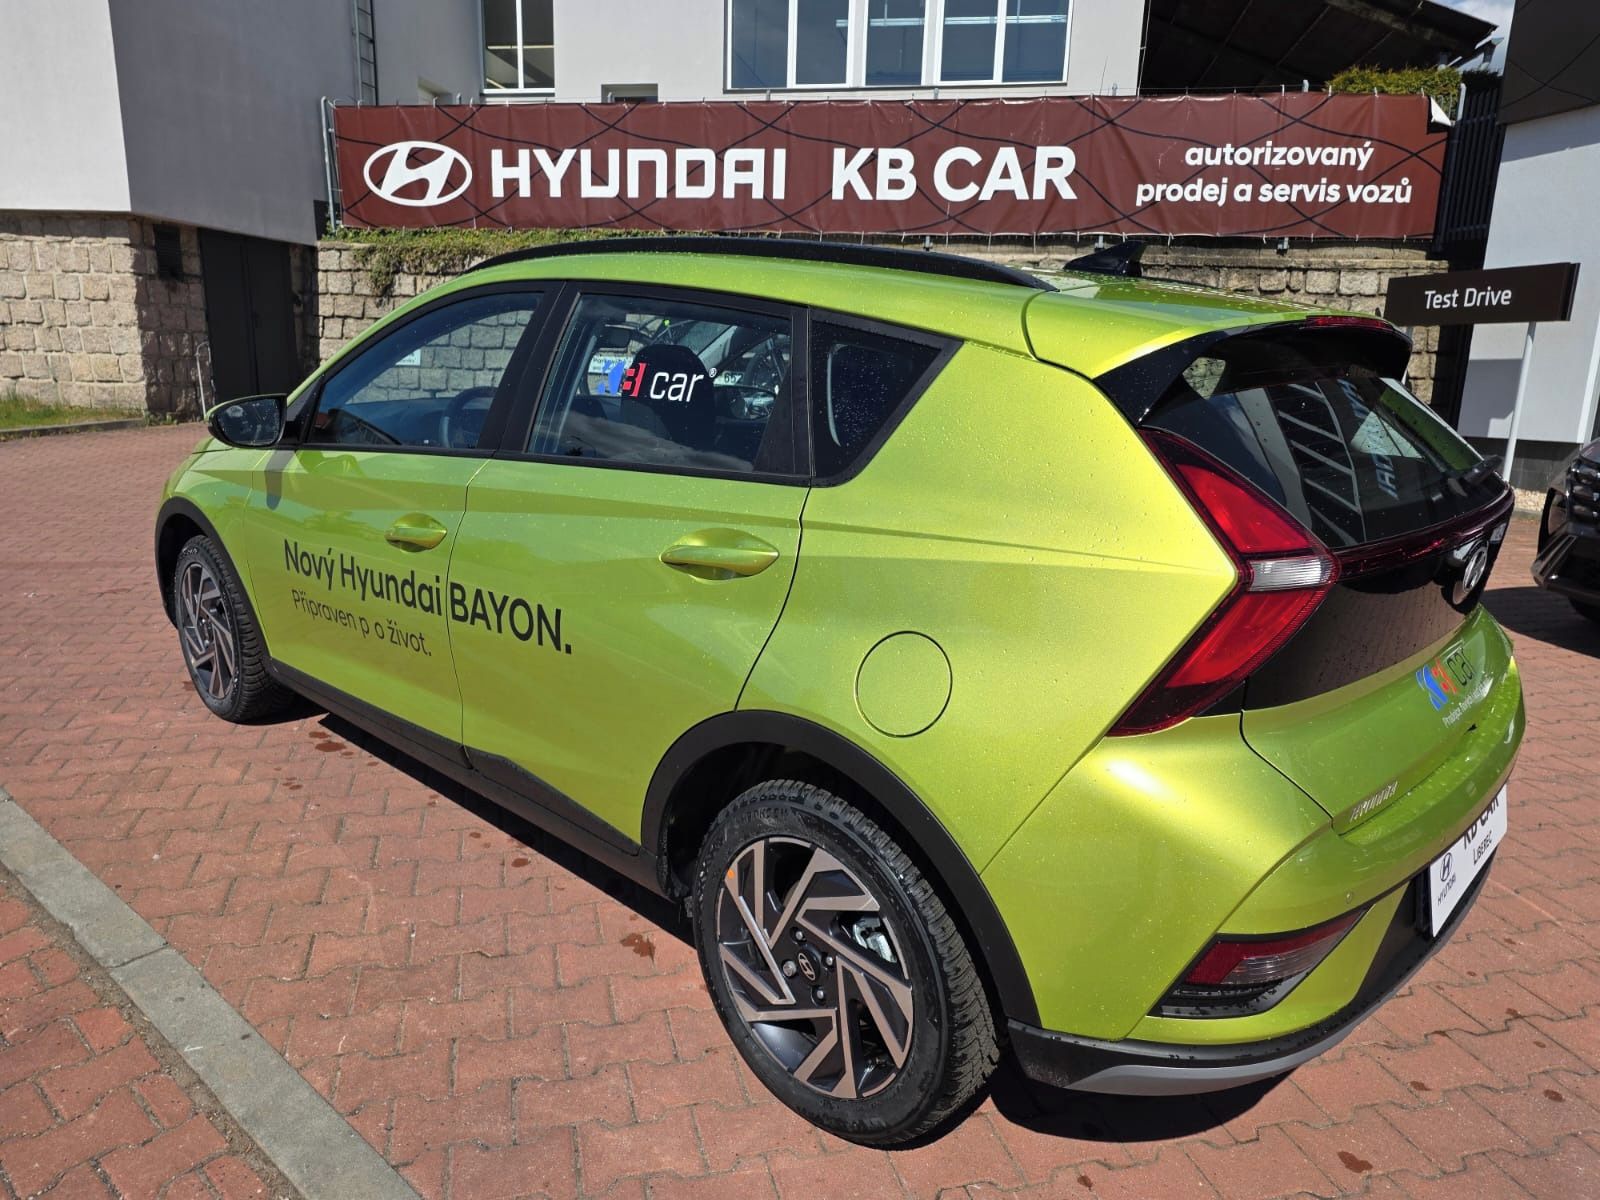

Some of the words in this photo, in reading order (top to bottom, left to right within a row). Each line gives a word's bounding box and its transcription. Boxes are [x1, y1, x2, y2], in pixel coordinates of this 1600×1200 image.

[490, 148, 786, 200] HYUNDAI
[831, 147, 918, 201] KB
[933, 146, 1078, 202] CAR
[1185, 141, 1374, 170] autorizovaný
[1136, 177, 1228, 207] prodej
[1233, 182, 1252, 202] a
[1258, 177, 1341, 202] servis
[1347, 177, 1412, 203] vozů
[1424, 289, 1459, 309] Test
[1463, 286, 1512, 307] Drive
[284, 538, 335, 591] Nový
[340, 553, 442, 616] Hyundai
[450, 581, 572, 654] BAYON.
[291, 588, 357, 630] Připraven
[387, 618, 432, 656] život.
